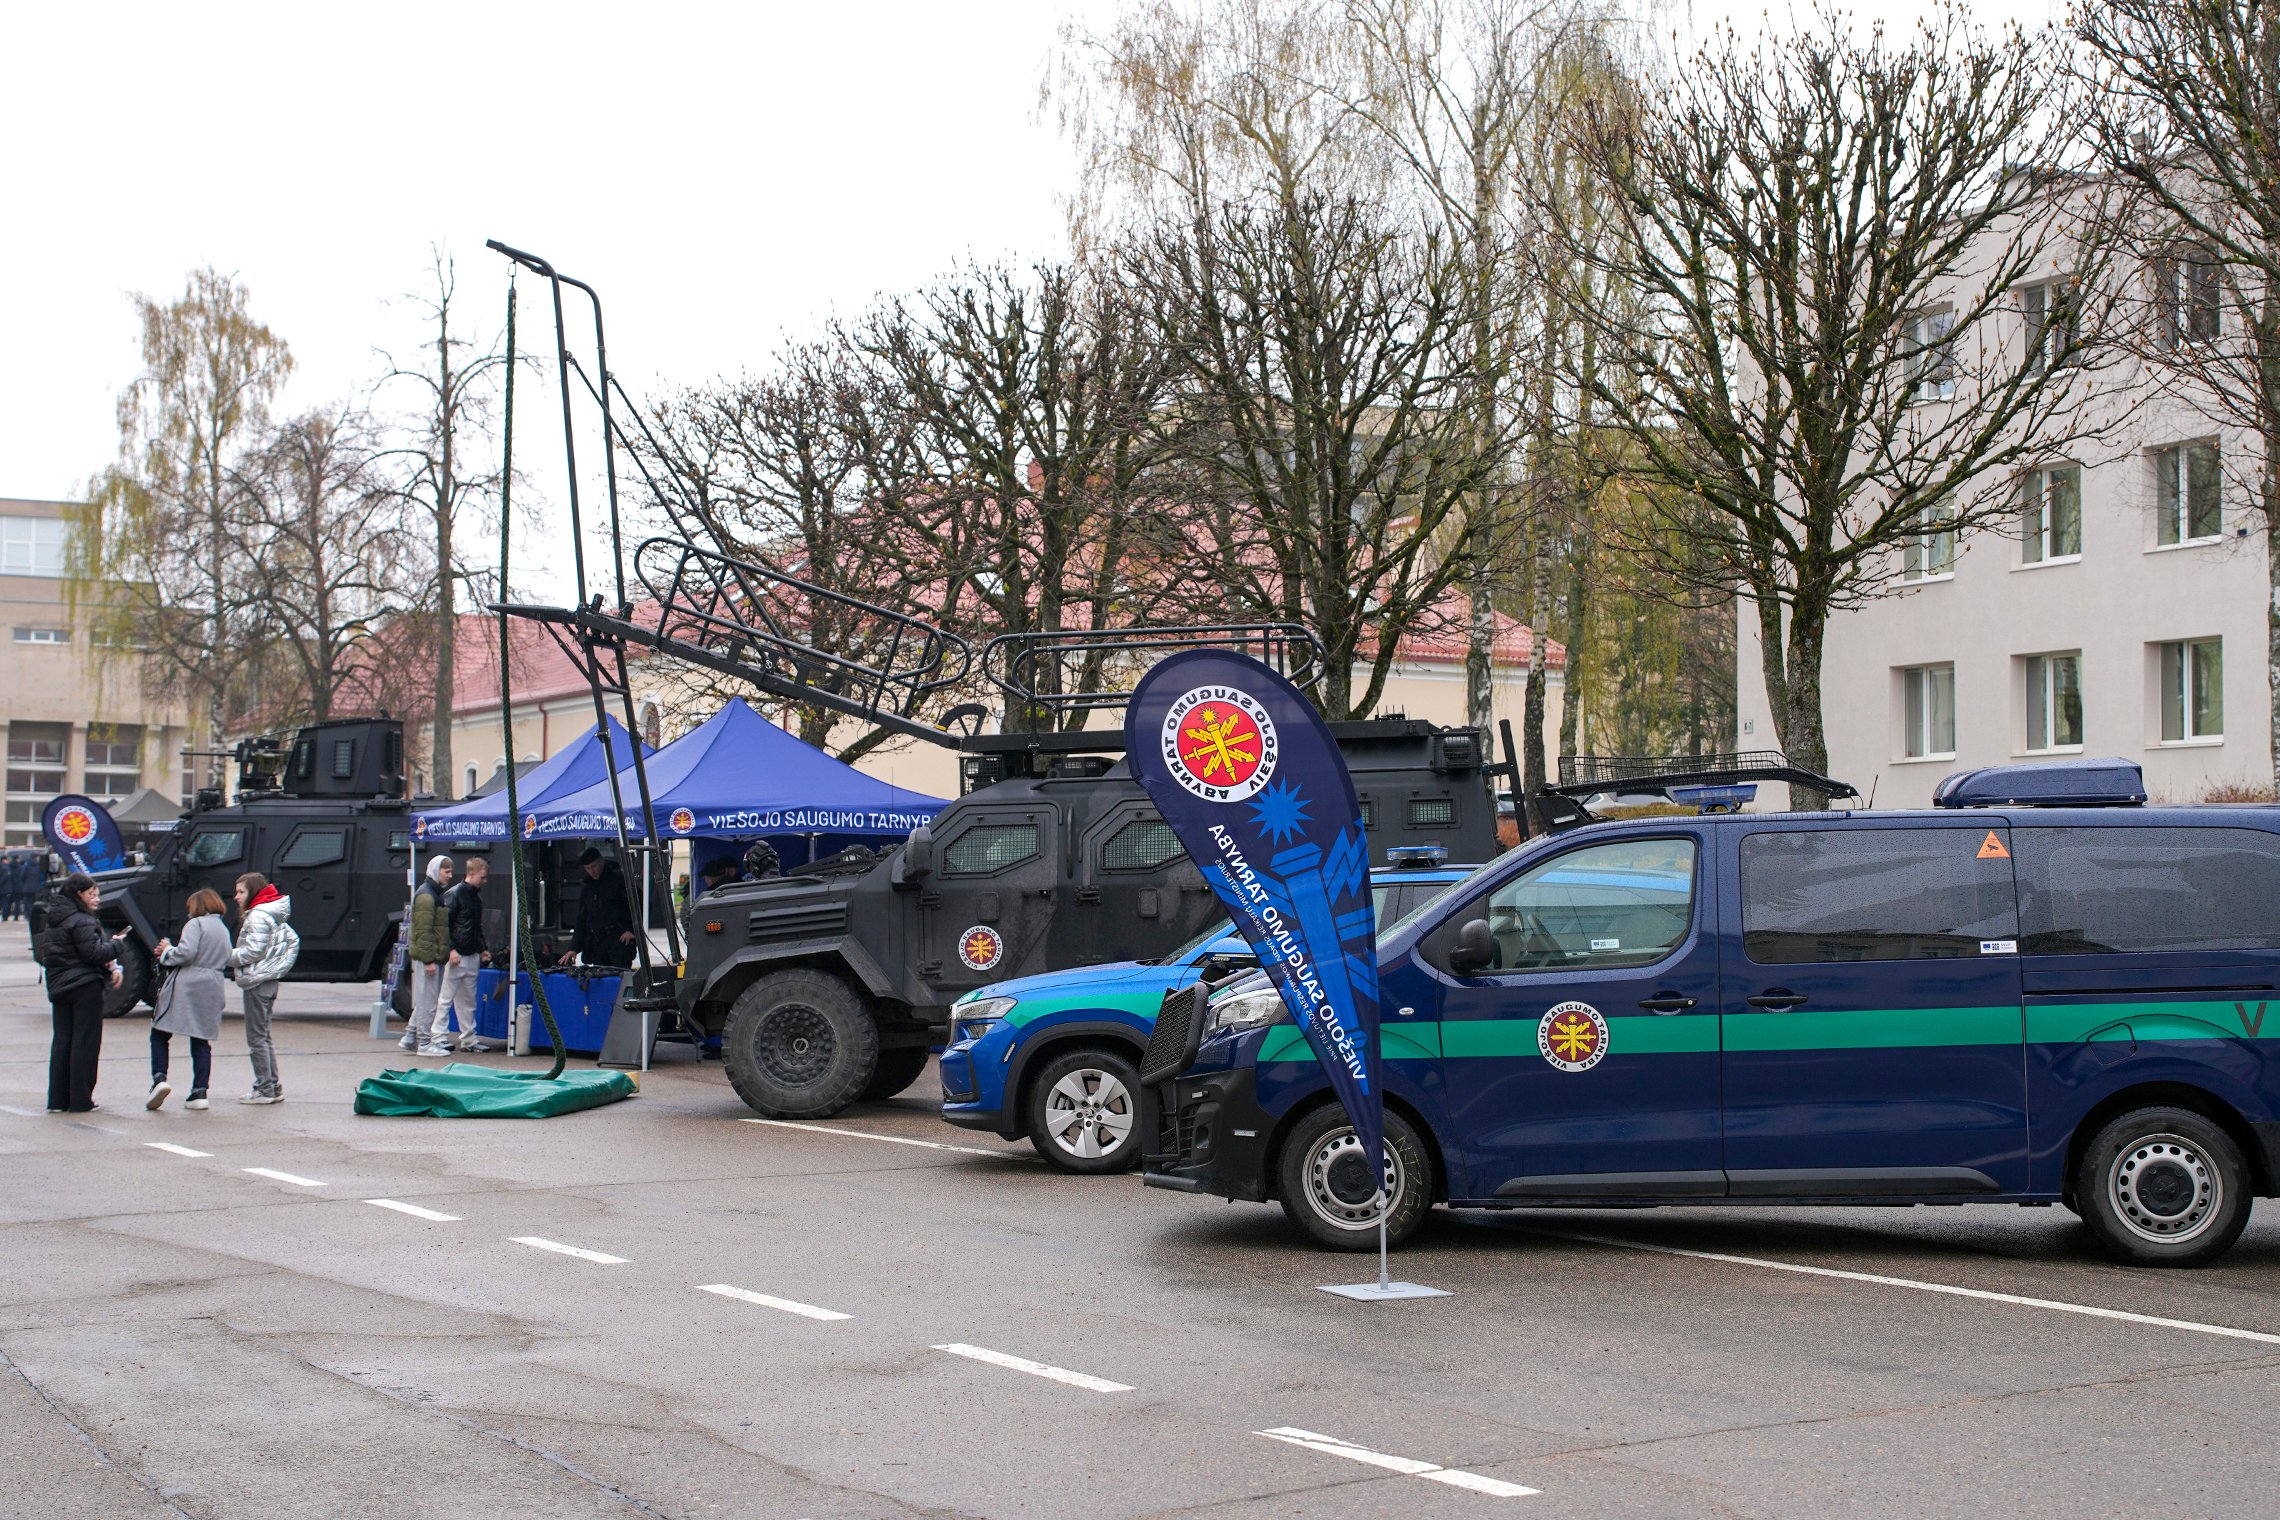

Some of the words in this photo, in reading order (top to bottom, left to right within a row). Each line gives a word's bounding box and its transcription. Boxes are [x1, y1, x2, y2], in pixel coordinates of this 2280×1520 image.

[708, 811, 782, 829] VIEŠOJO
[784, 811, 864, 828] SAUGUMO
[868, 813, 936, 829] TARNYB
[1545, 1004, 1599, 1024] SAUGUMO
[1579, 1022, 1607, 1069] TARNYBA
[2234, 1002, 2267, 1037] V
